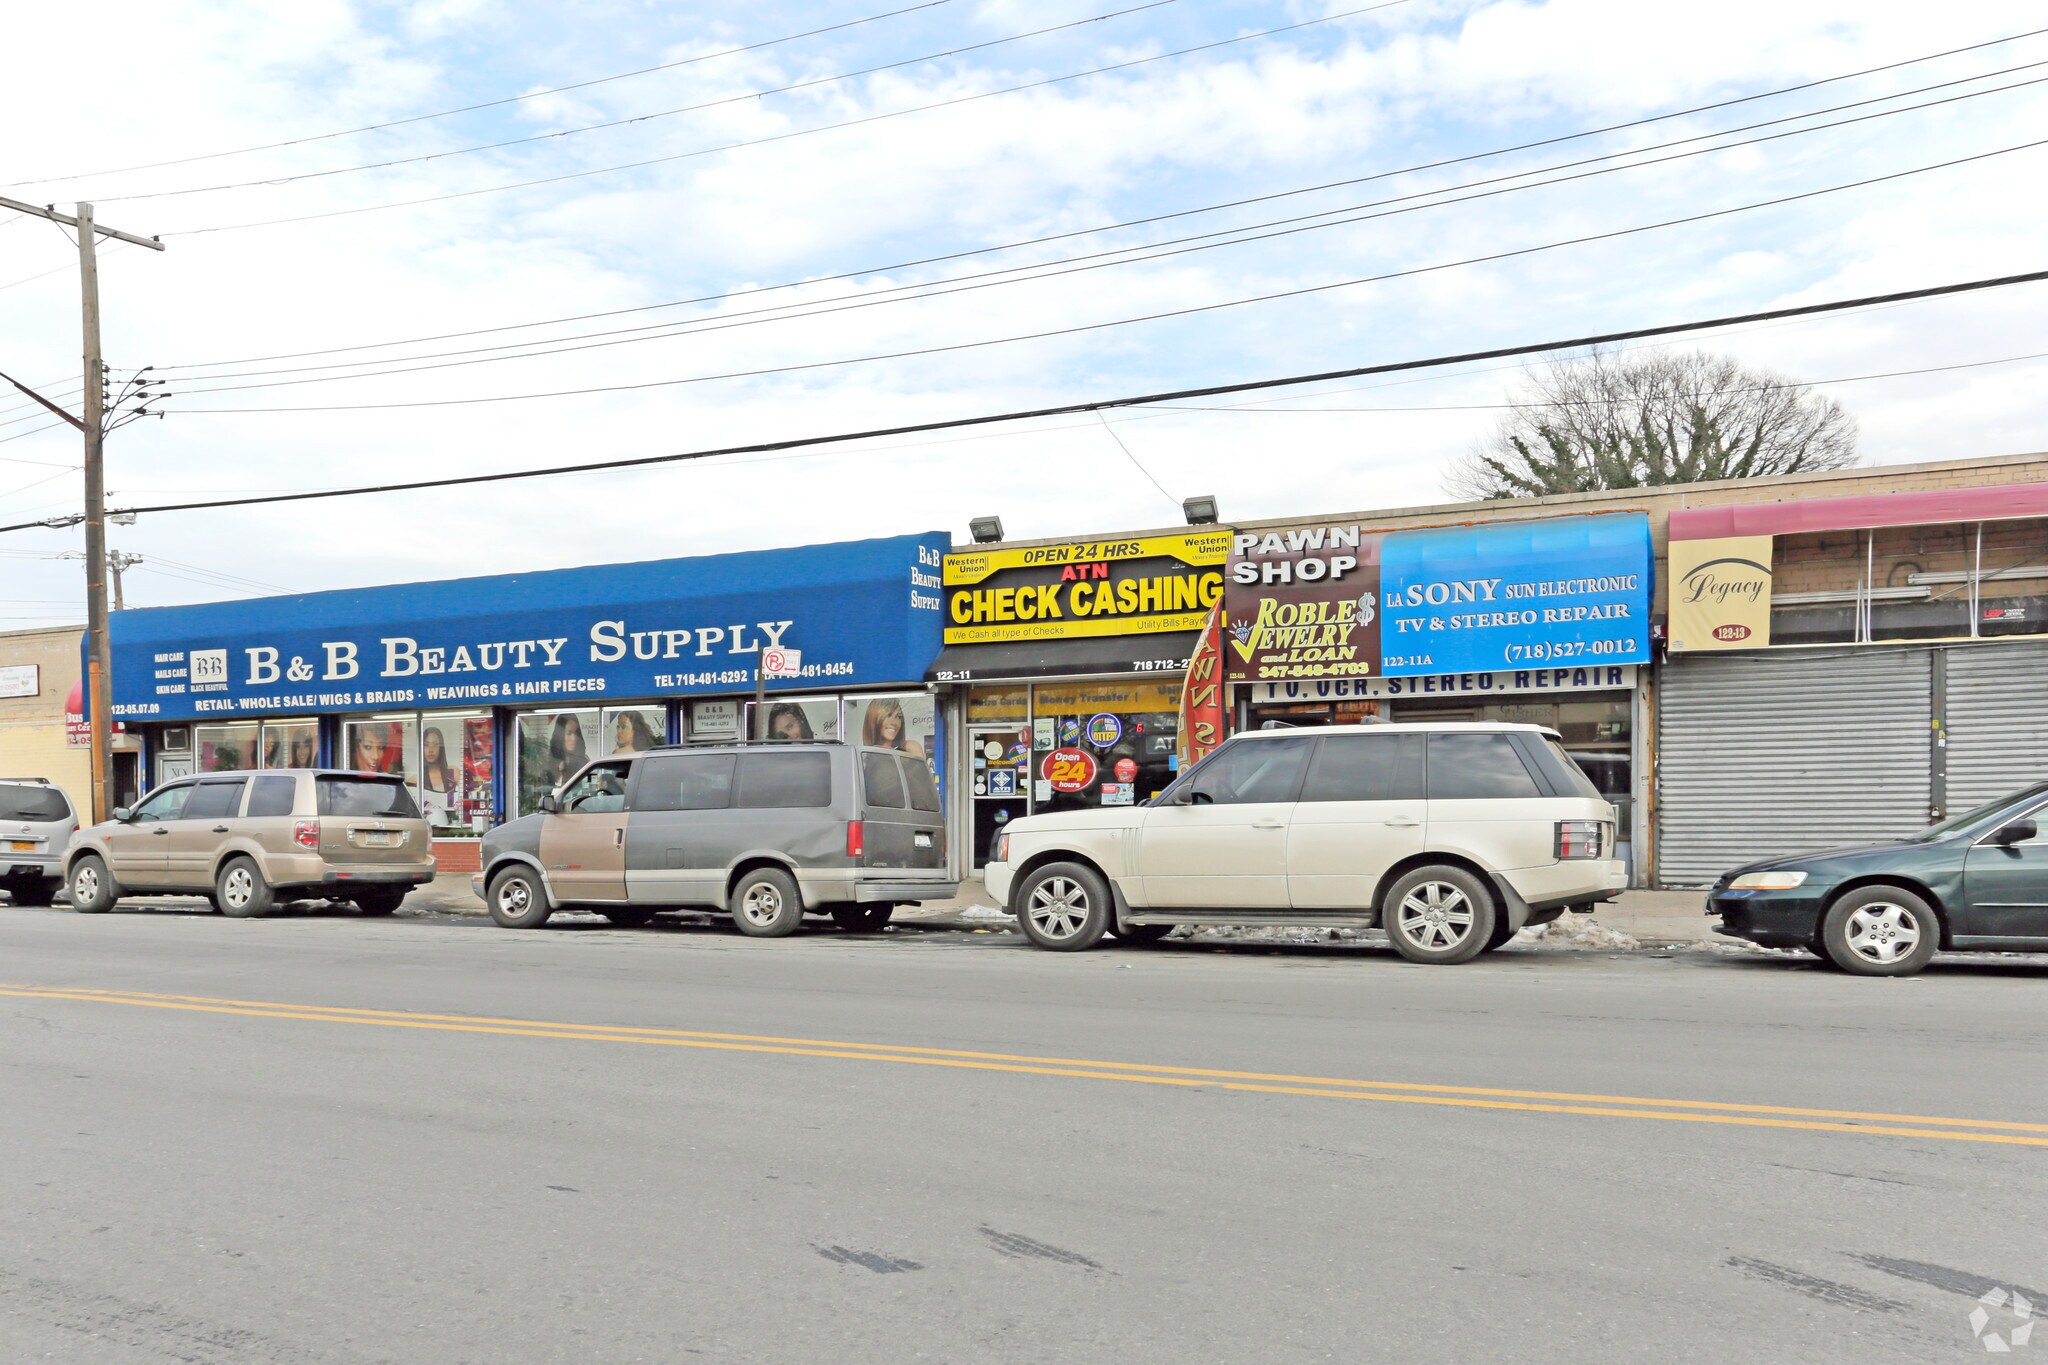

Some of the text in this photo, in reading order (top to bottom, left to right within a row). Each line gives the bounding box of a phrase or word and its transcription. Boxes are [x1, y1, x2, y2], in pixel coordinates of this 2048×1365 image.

[1184, 536, 1227, 546] Western
[1234, 525, 1360, 556] PAWN
[1023, 542, 1145, 563] OPEN 24 HRS.
[1198, 545, 1227, 554] Union
[947, 557, 985, 566] Western
[959, 565, 985, 573] Union
[1232, 556, 1357, 584] SHOP
[910, 566, 942, 589] BEAUTY
[1061, 562, 1108, 581] ATN
[1386, 574, 1639, 608] LA SONY SUN ELECTRONIC
[1682, 573, 1768, 604] Legacy
[910, 590, 940, 610] SUPPLY
[951, 572, 1224, 624] CHECK CASHING
[1137, 617, 1204, 630] Utility Bills Pay
[1395, 603, 1632, 633] TV & STEREO REPAIR
[953, 626, 1065, 640] We Cash all type of Checks
[154, 652, 184, 662] HAIR CARE
[380, 637, 568, 677] BEAUTY
[590, 620, 793, 662] SUPPLY
[1260, 646, 1358, 663] and LOAN
[1504, 638, 1637, 663] (718)527-0012
[1133, 660, 1153, 671] 718
[1383, 654, 1434, 667] 122-11A
[155, 668, 188, 679] NAILS CARE
[654, 674, 674, 688] TEL
[676, 669, 748, 686] 718-481-6292
[936, 670, 971, 681] 122-11
[1514, 667, 1623, 688] REPAIR
[156, 684, 186, 694] SKIN CARE
[190, 683, 228, 692] BLACK BEAUTIFUL
[239, 696, 281, 710] WHOLE
[283, 694, 317, 708] SALE/
[318, 693, 351, 706] WIGS
[354, 692, 364, 704] &
[366, 689, 414, 704] BRAIDS
[427, 684, 498, 700] WEAVINGS
[501, 683, 512, 695] &
[515, 680, 550, 695] HAIR
[553, 677, 606, 692] PIECES
[1039, 691, 1128, 705] Money Transfer
[111, 703, 160, 715] 122-05.07.09
[1054, 752, 1080, 762] Open
[1051, 761, 1087, 782] 24
